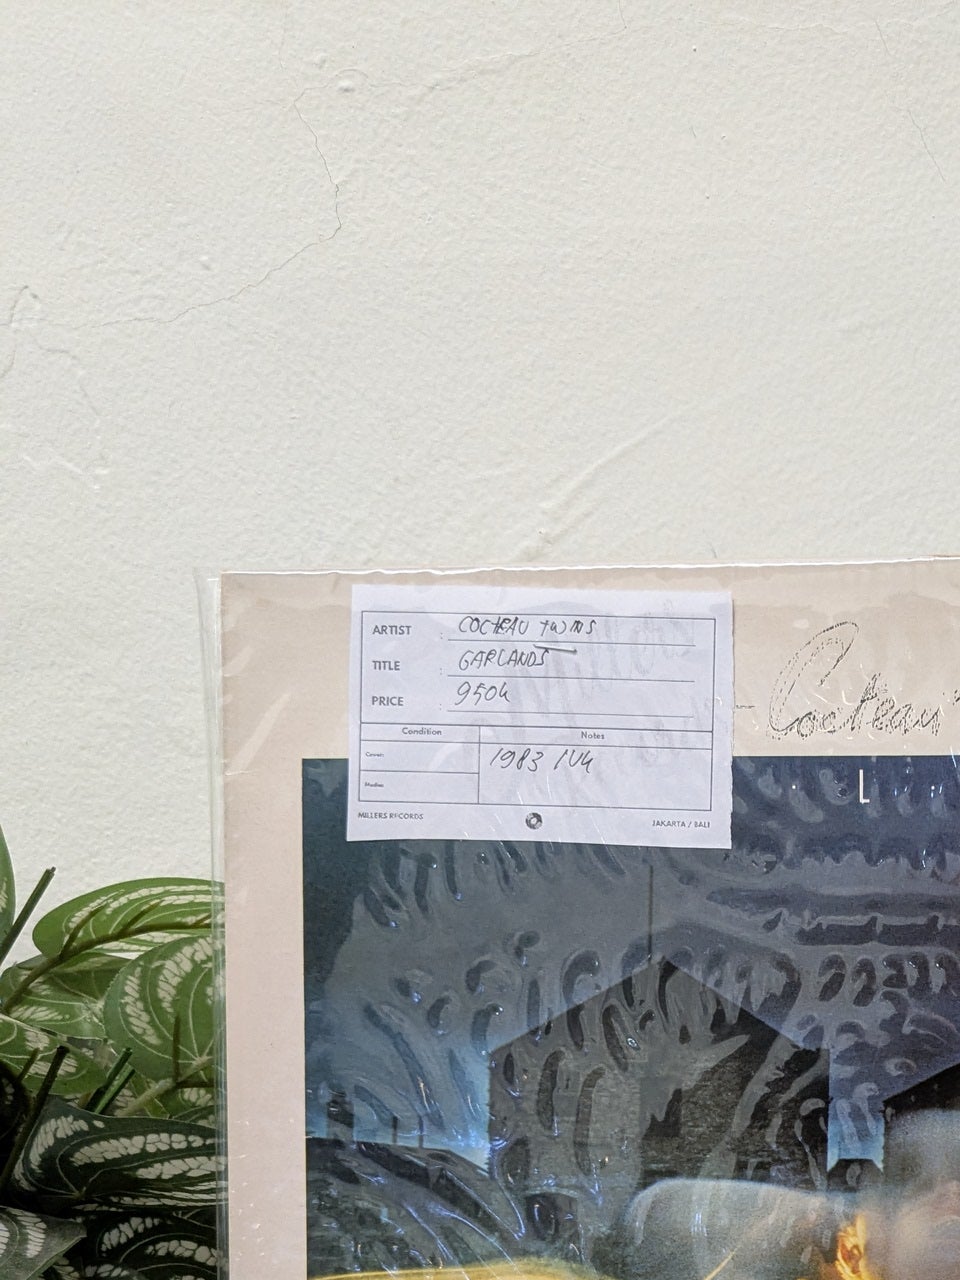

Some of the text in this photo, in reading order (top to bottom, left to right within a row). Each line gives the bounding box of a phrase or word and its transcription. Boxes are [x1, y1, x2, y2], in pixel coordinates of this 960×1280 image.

[372, 625, 412, 636] ARTIST
[372, 660, 401, 671] TITLE
[371, 695, 404, 707] PRICE
[401, 727, 442, 736] Condition
[581, 731, 605, 740] Notes
[489, 747, 544, 773] 1983
[358, 812, 388, 820] MILLERS
[652, 820, 686, 828] JAKARTA
[694, 821, 711, 829] BALI
